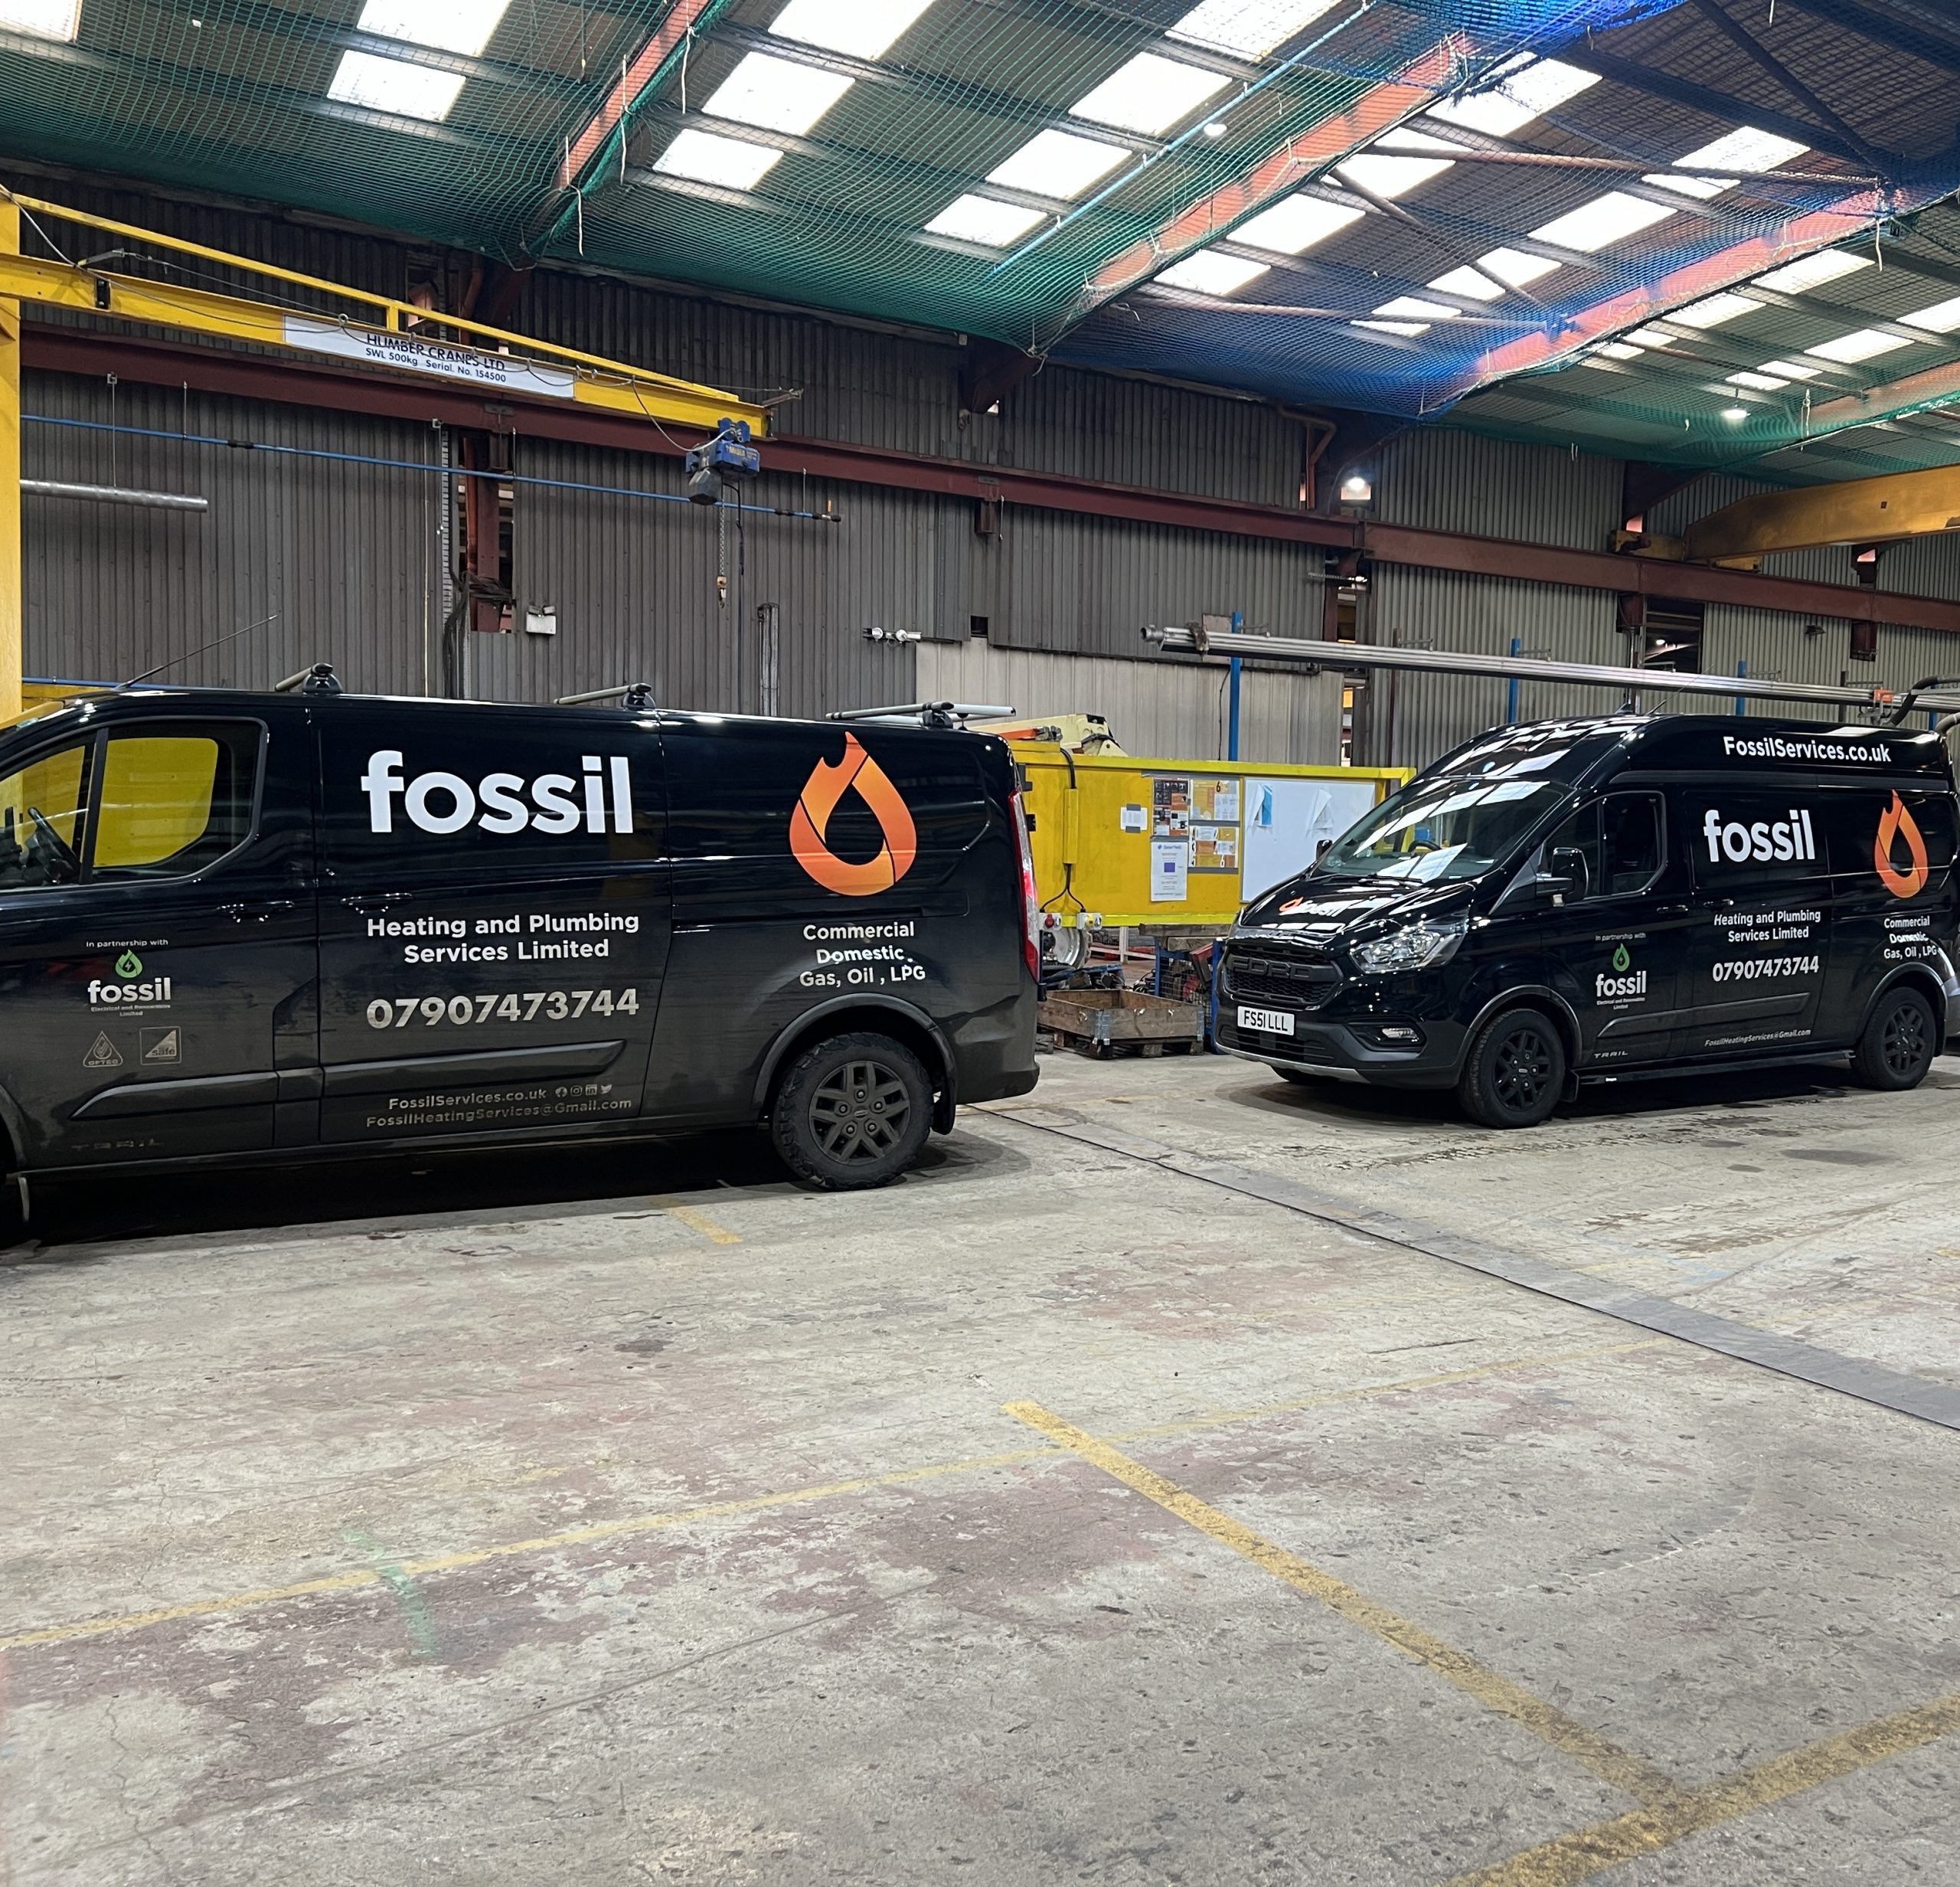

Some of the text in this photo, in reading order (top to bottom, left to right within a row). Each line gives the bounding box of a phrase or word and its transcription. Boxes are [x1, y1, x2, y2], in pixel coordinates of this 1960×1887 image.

[366, 334, 505, 371] HUMBER CRANES LTD
[366, 348, 385, 358] SWL
[389, 353, 418, 366] 500kg
[475, 369, 506, 382] 154500
[1723, 736, 1892, 762] FossilServices.co.uk
[361, 750, 634, 835] fossil
[1704, 809, 1815, 862] fossil
[367, 913, 639, 938] Heating and Plumbing
[1713, 909, 1821, 927] Heating and Plumbing
[1883, 915, 1930, 928] Commercial
[803, 921, 915, 940] Commercial
[1728, 926, 1809, 943] Services Limited
[96, 940, 147, 948] partnership
[404, 939, 609, 963] Services Limited
[816, 945, 905, 964] Domestic
[1883, 948, 1903, 960] Gas,
[1922, 945, 1937, 956] LPG
[799, 971, 841, 988] Gas,
[890, 965, 926, 981] LPG
[1713, 956, 1819, 982] 07907473744
[87, 977, 171, 1003] fossil
[1596, 970, 1647, 997] fossil
[366, 989, 639, 1029] 07907473744
[1244, 1010, 1288, 1032] FS51 LLL
[388, 1089, 547, 1110] FossilServices.co.uk
[367, 1099, 632, 1127] FossilHeatingServices@Gmail.com
